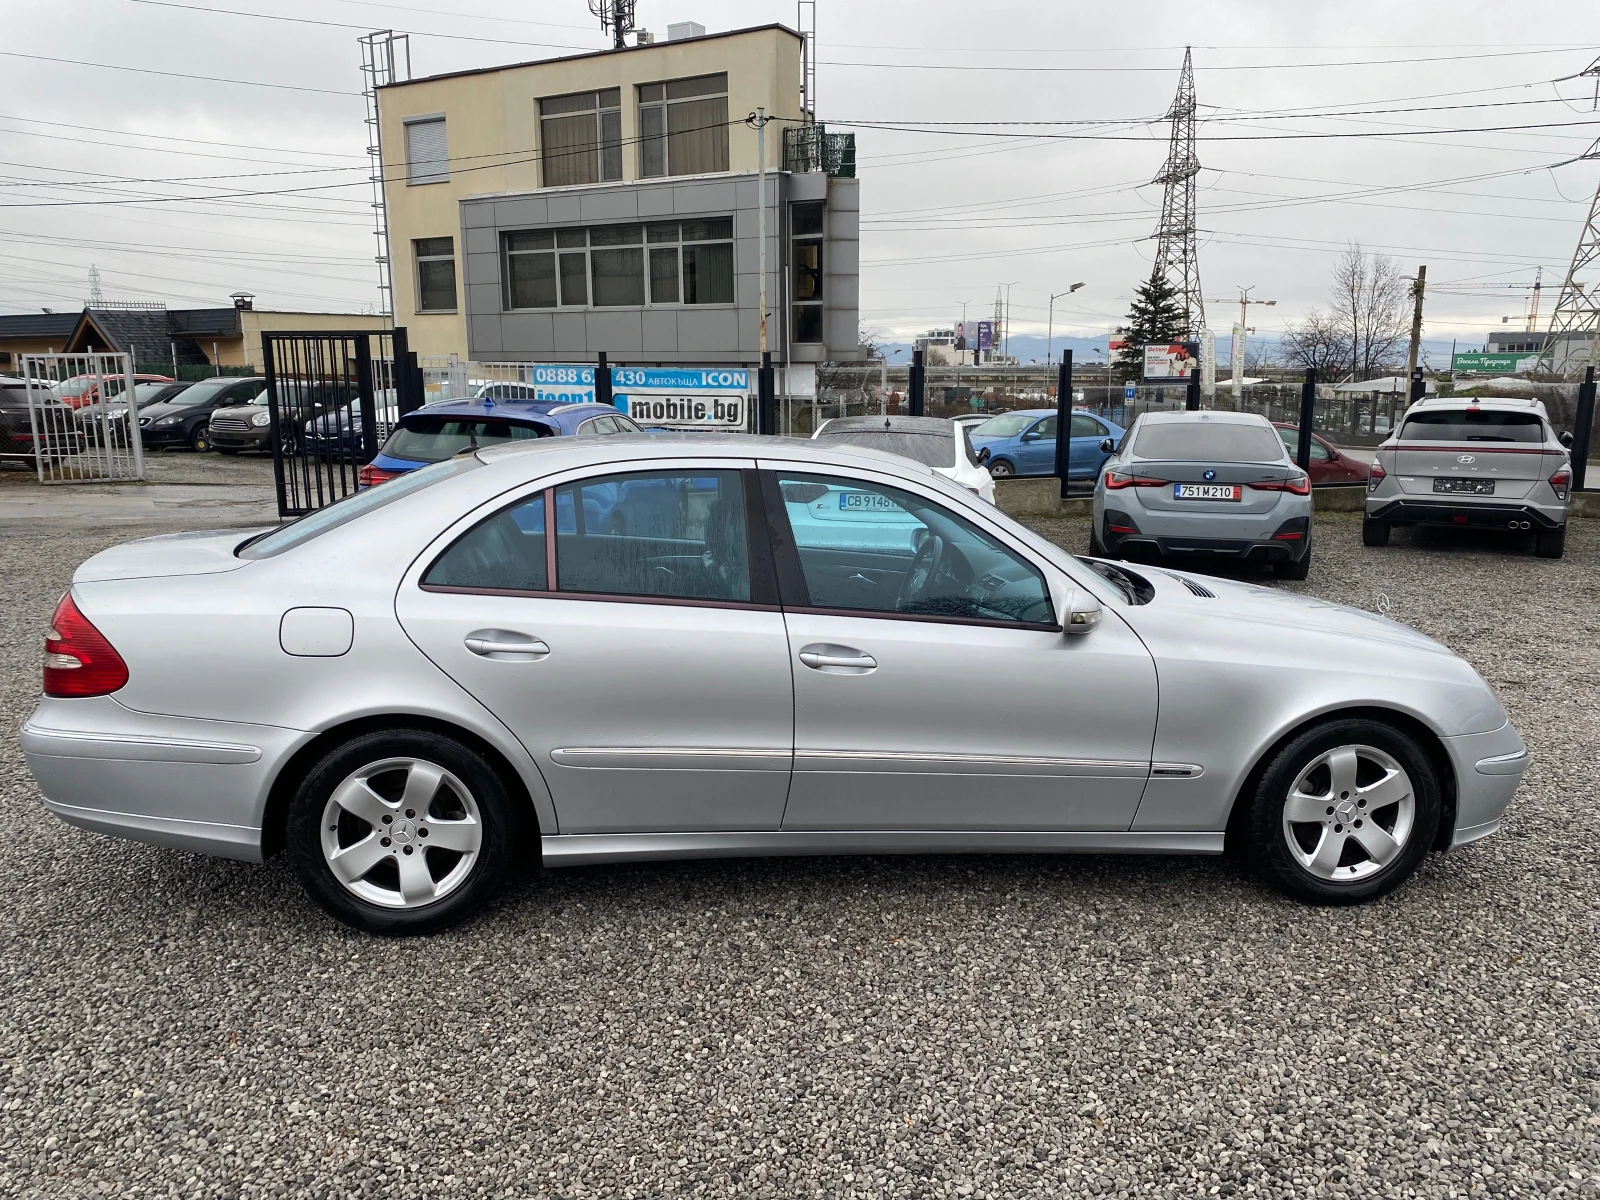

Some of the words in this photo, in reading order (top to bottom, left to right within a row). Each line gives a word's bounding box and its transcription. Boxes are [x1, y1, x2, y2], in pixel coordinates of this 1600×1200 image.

[1480, 357, 1512, 367] Празници
[536, 368, 578, 383] 0888
[581, 369, 596, 383] 6
[615, 370, 646, 385] 430
[647, 377, 699, 387] АВТОКЪЩА
[701, 372, 746, 386] ICON
[631, 398, 739, 422] mobile.bg
